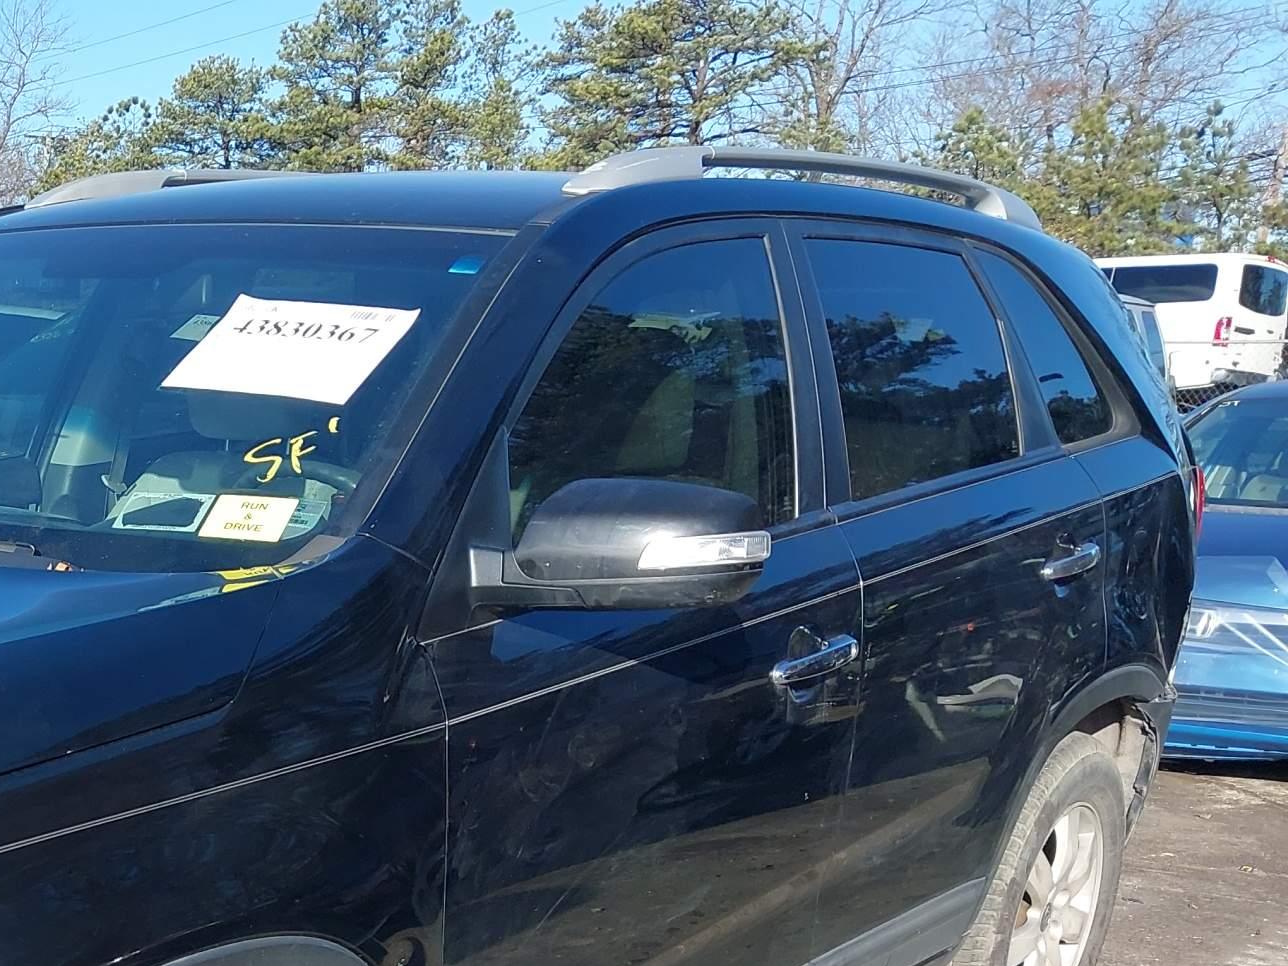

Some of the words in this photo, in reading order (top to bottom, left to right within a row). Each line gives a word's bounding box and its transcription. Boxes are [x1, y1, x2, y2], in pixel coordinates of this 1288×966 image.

[233, 318, 380, 344] 43830367
[240, 501, 270, 511] RUN
[243, 512, 253, 521] &
[223, 522, 264, 533] DRIVE
